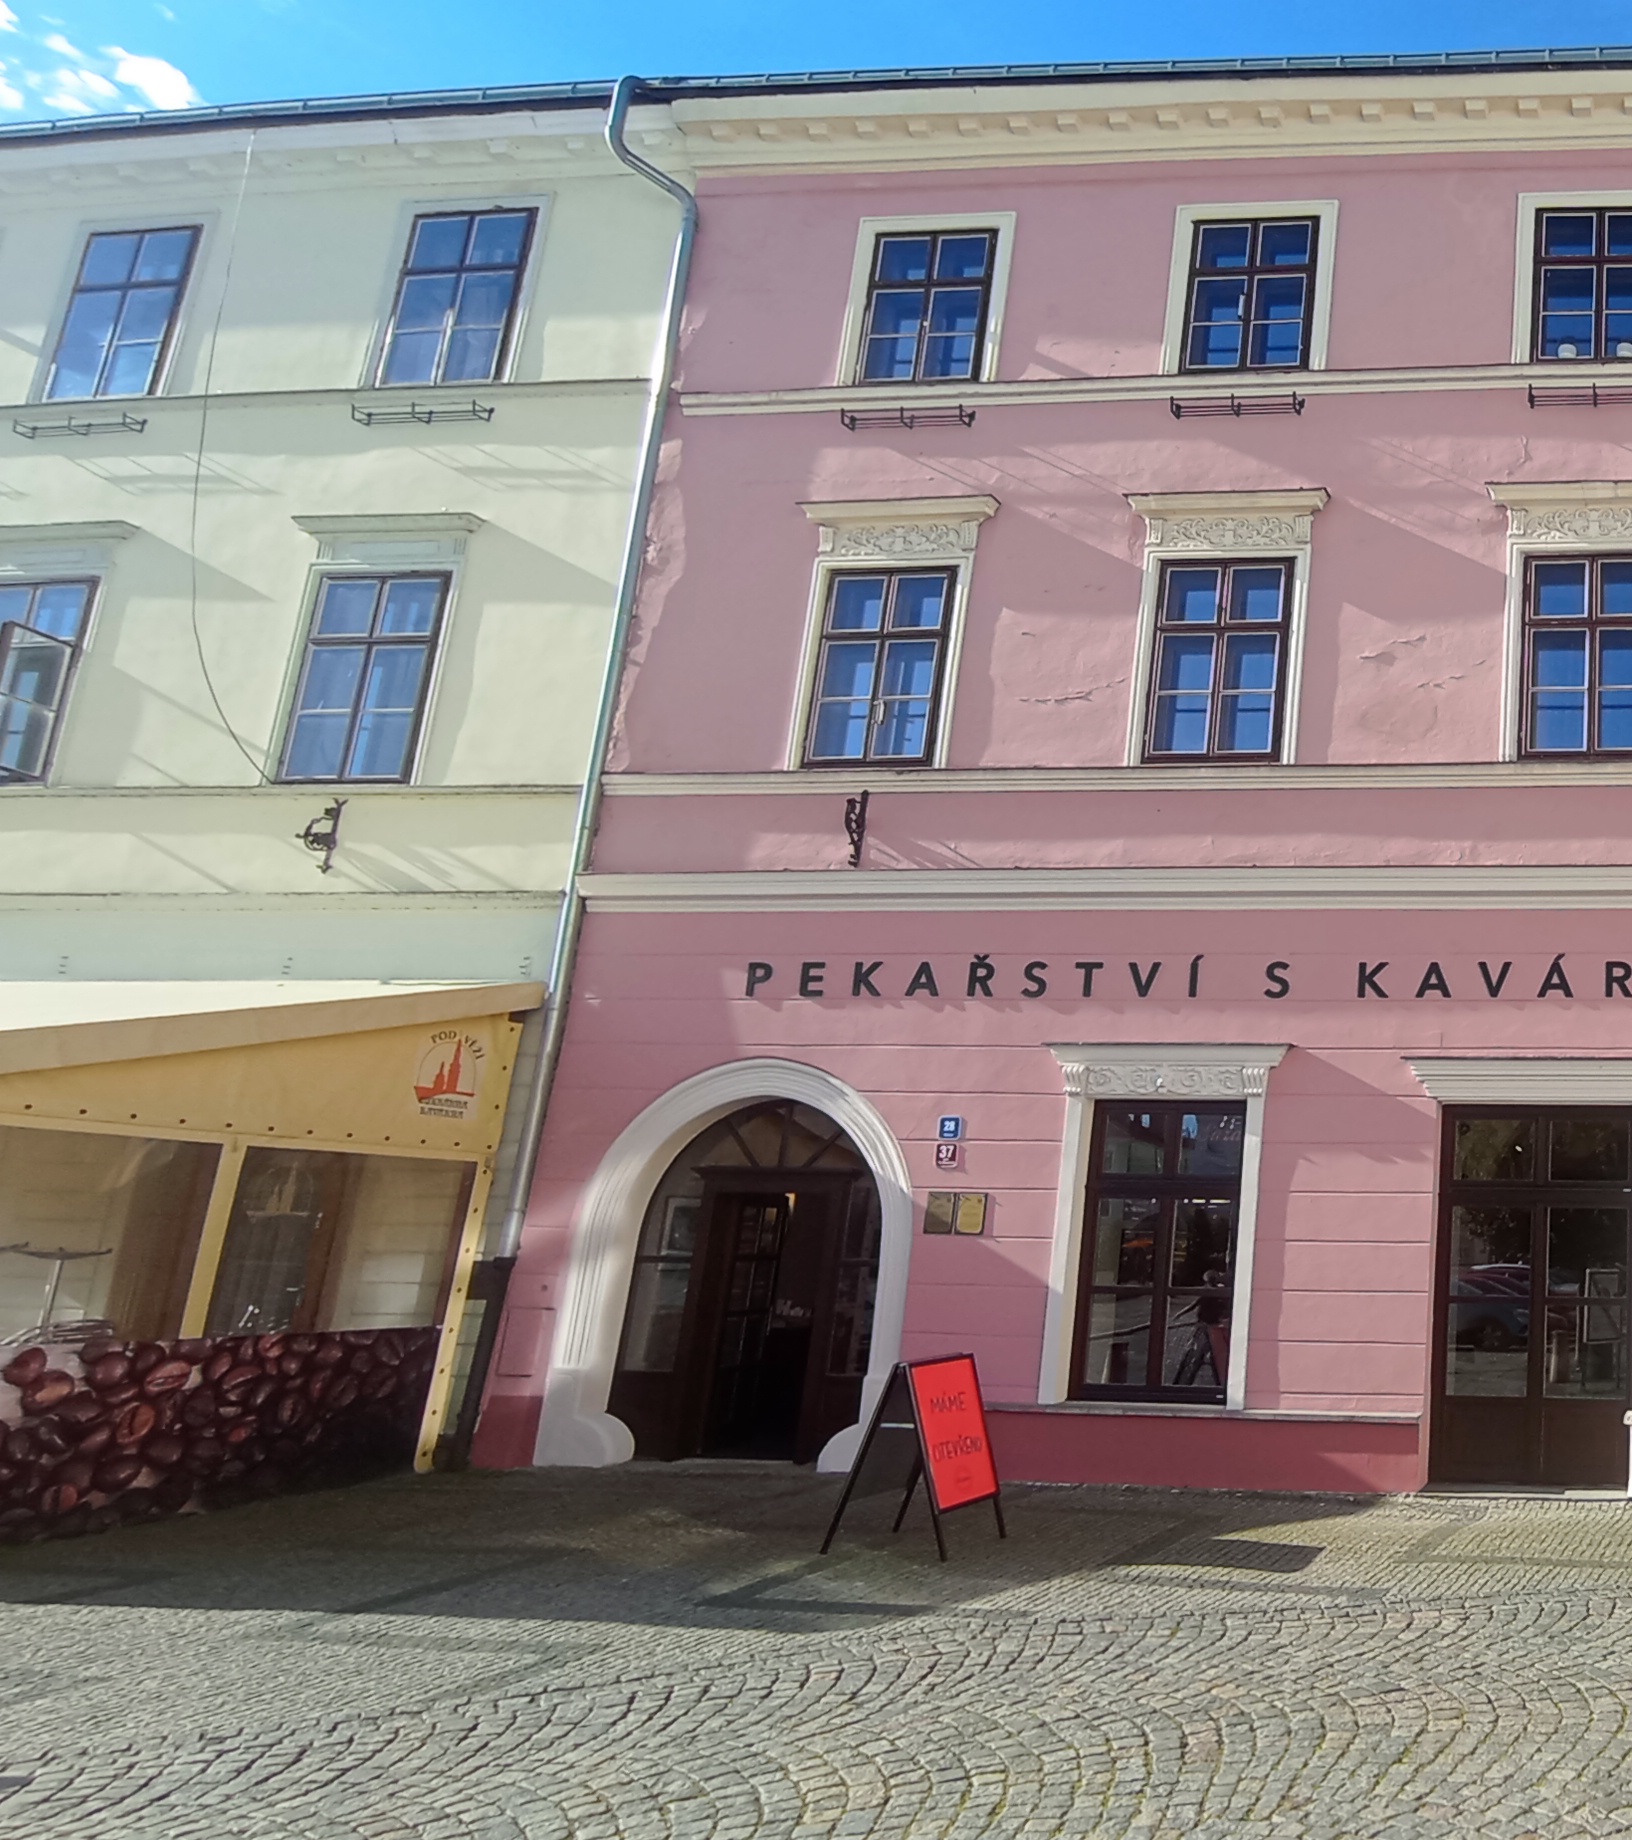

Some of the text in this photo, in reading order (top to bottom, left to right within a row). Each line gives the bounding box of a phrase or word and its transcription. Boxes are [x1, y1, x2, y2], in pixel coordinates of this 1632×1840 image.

[744, 953, 1204, 998] PEKAŘSTVÍ
[1263, 961, 1291, 998] S
[431, 1030, 457, 1044] POD
[943, 1120, 956, 1132] 28
[939, 1145, 955, 1160] 37
[930, 1391, 967, 1414] MÁME
